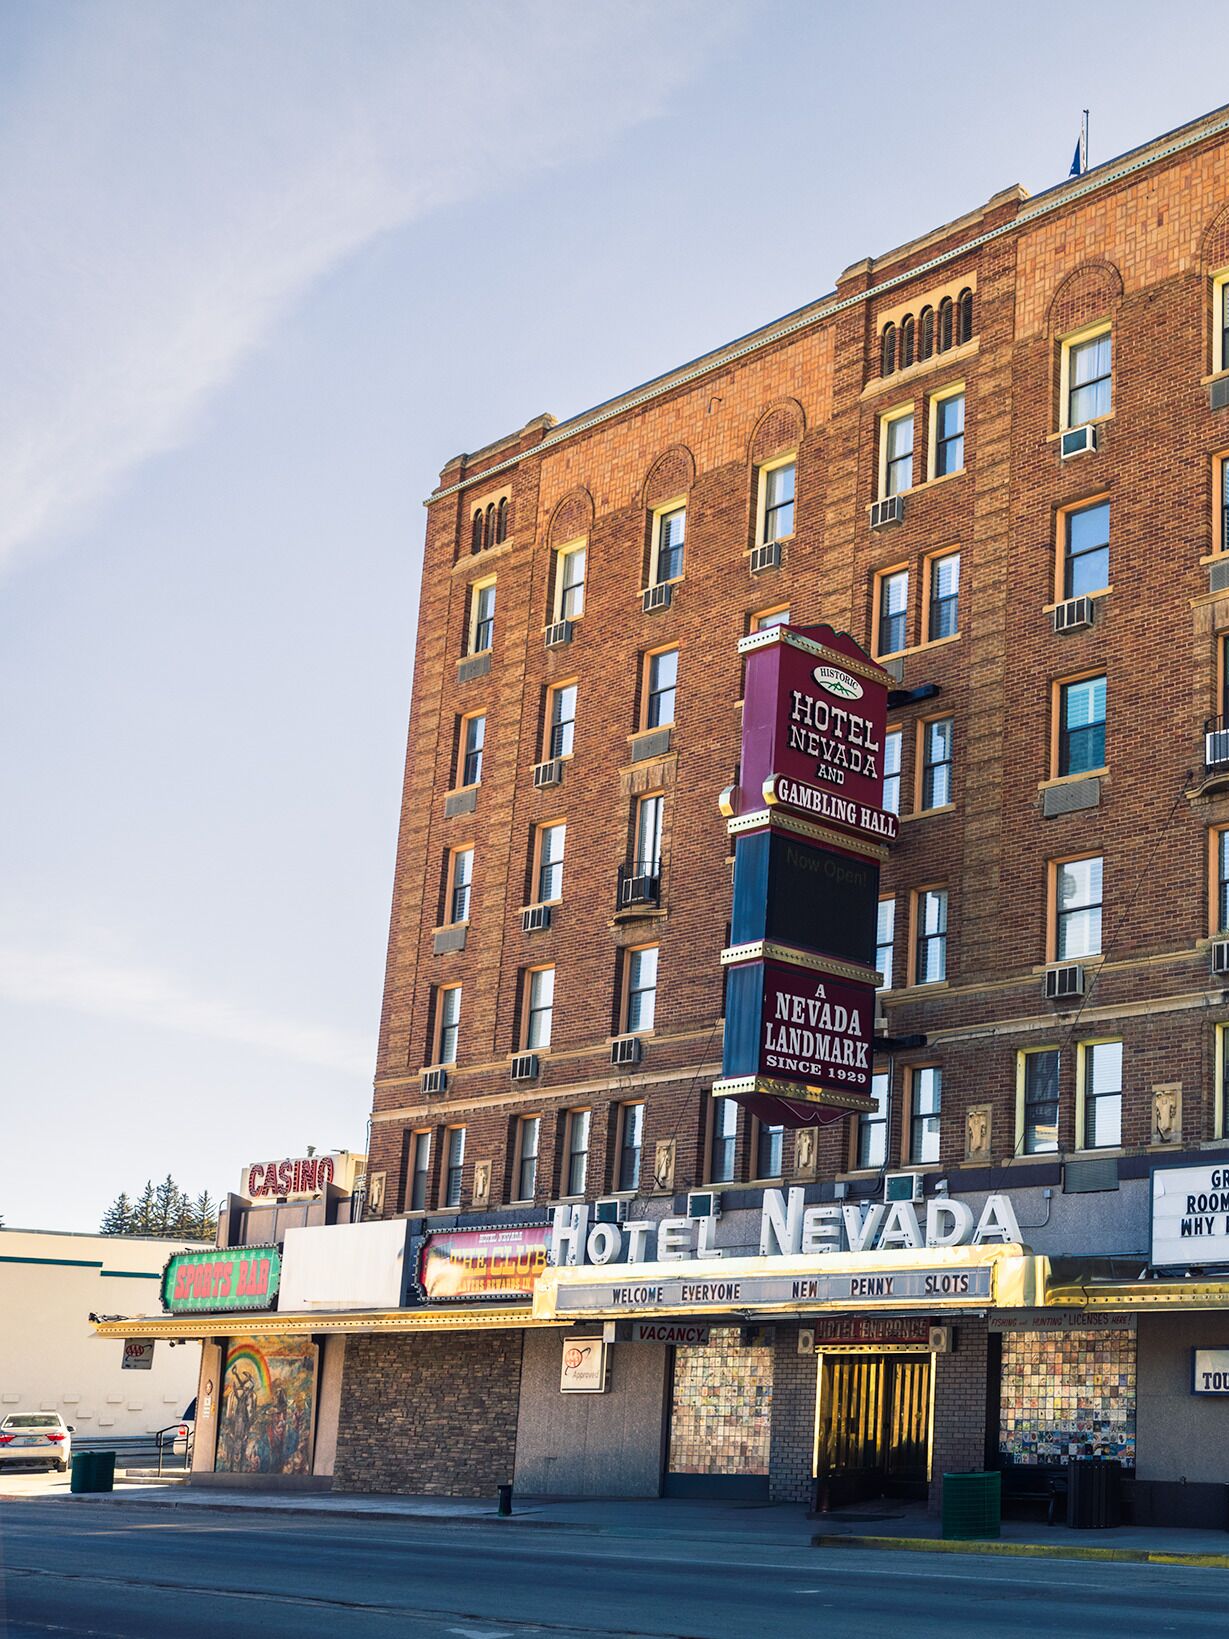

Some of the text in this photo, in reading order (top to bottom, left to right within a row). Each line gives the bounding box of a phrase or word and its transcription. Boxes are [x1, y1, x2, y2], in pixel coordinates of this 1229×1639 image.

[820, 668, 859, 690] HISTORIC
[791, 691, 880, 752] HOTEL
[790, 725, 878, 779] NEVADA
[818, 763, 845, 785] AND
[778, 778, 896, 838] GAMBLING HALL
[786, 846, 867, 888] Now Open!
[815, 983, 827, 999] A
[775, 991, 862, 1037] NEVADA
[765, 1023, 869, 1069] LANDMARK
[766, 1055, 867, 1084] SINCE 1929
[248, 1157, 335, 1197] CASINO
[551, 1186, 1024, 1266] HOTEL NEVADA
[1181, 1216, 1215, 1237] WHY
[450, 1243, 547, 1277] THE CLUB
[174, 1258, 271, 1300] SPORTS BAR
[612, 1274, 970, 1303] WELCOME EVERYONE NEW PENNY SLOTS
[638, 1325, 705, 1342] VACANCY
[817, 1317, 928, 1339] HOTEL ENTRANCE
[1068, 1311, 1109, 1326] LICENSES
[572, 1370, 600, 1381] Approved
